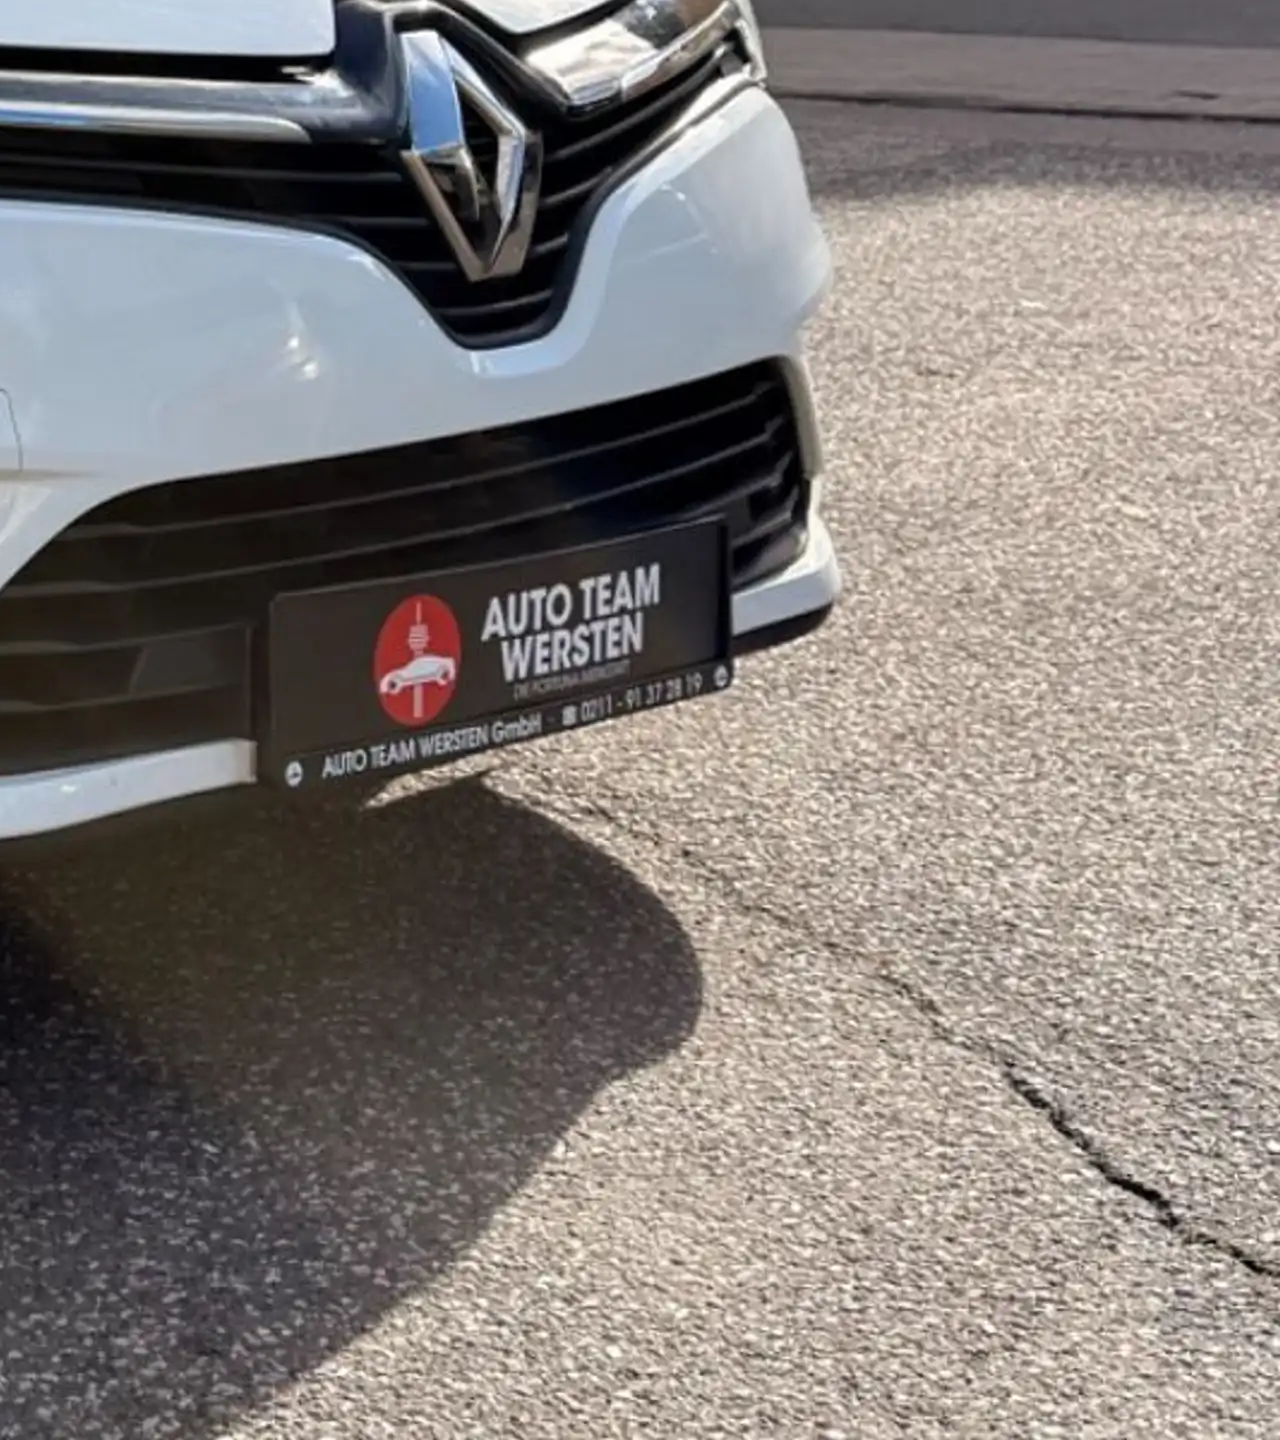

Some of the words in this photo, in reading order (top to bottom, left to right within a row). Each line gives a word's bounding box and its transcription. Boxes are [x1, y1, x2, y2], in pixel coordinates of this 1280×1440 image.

[480, 583, 572, 643] AUTO
[579, 563, 660, 620] TEAM
[501, 612, 643, 683] WERSTEN
[322, 749, 368, 779] AUTO
[370, 738, 416, 769] TEAM
[419, 723, 489, 758] WERSTEN
[492, 711, 541, 741] GmbH
